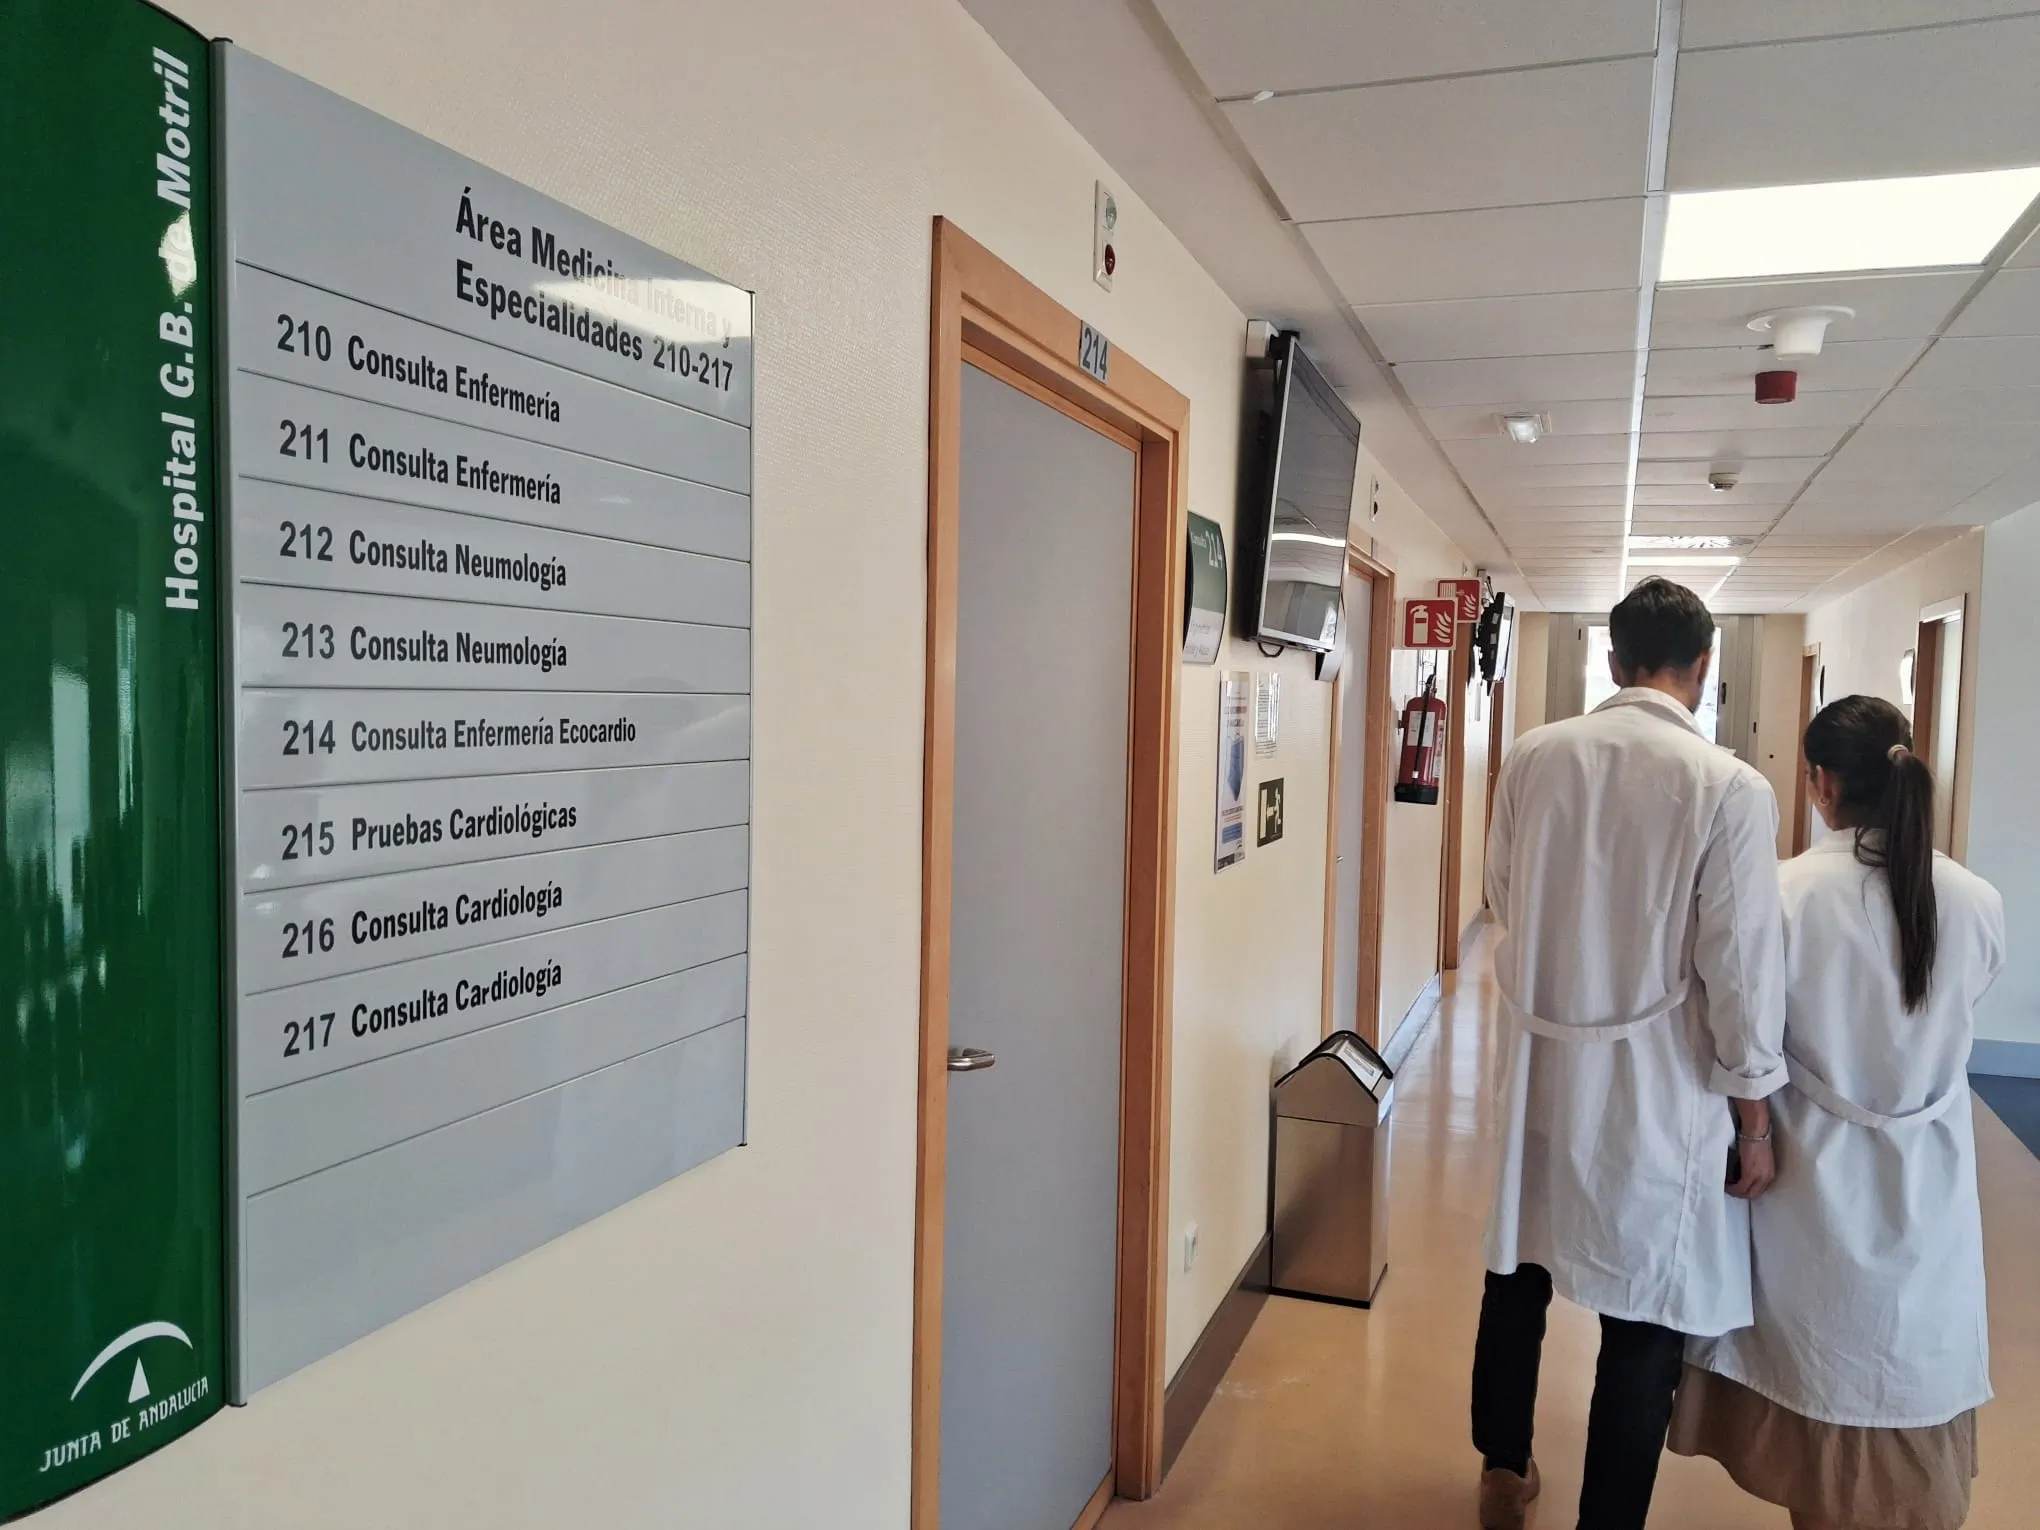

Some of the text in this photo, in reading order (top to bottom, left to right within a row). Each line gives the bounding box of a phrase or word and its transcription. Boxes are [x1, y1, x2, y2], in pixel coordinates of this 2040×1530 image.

[152, 46, 191, 210] Motril
[455, 185, 522, 258] Área
[531, 226, 638, 308] Medicina
[159, 301, 195, 398] G.B.
[277, 313, 561, 423] 210 Consulta Enfermería
[455, 258, 734, 393] Especialidades 210-217
[1082, 327, 1107, 380] 214
[279, 419, 561, 505] 211 Consulta Enfermería
[161, 411, 204, 610] Hospital
[279, 520, 567, 592] 212 Consulta Neumología
[281, 621, 567, 673] 213 Consulta Neumología
[282, 716, 636, 756] 214 Consulta Enfermería Ecocardio
[281, 801, 577, 861] 215 Pruebas Cardiológicas
[281, 880, 563, 959] 216 Consulta Cardiología
[283, 958, 562, 1058] 217 Consulta Cardiología
[39, 1431, 102, 1473] JUNTA
[110, 1417, 131, 1443] DE
